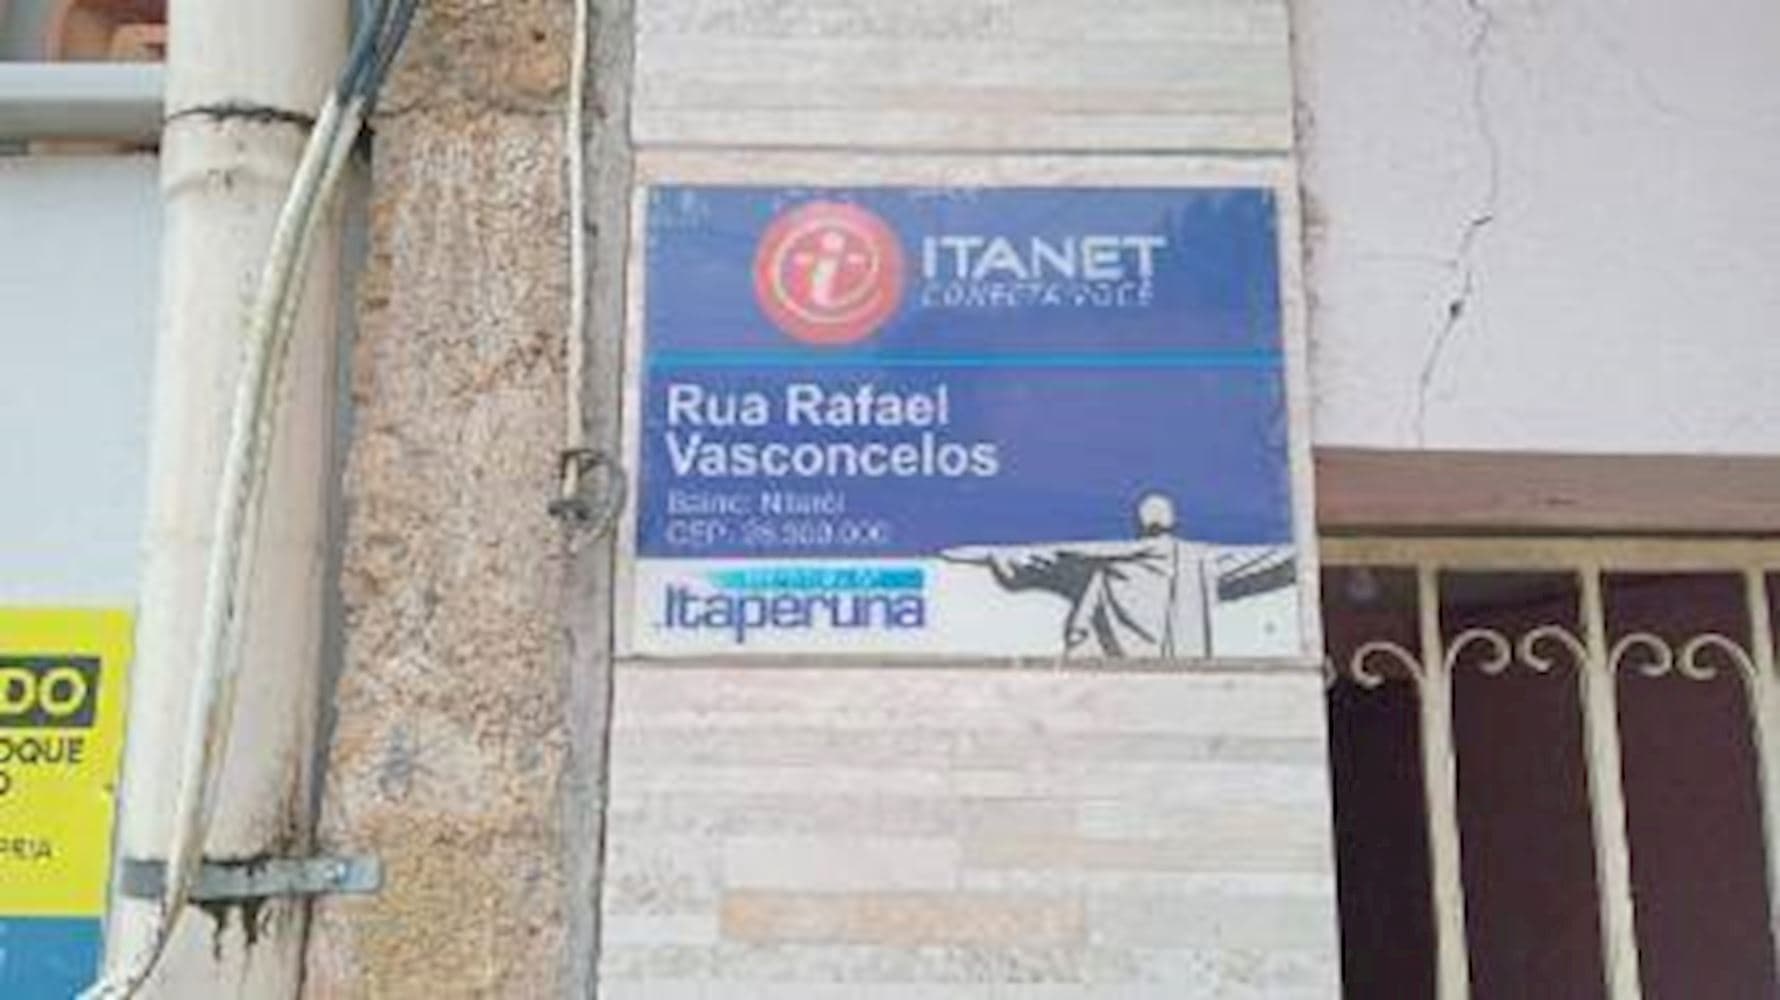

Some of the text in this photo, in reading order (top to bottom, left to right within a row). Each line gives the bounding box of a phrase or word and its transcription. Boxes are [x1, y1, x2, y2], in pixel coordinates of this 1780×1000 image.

[921, 235, 1167, 280] ITANET
[667, 384, 948, 426] Rua Rafael
[666, 434, 999, 478] Vasconcelos
[664, 584, 926, 644] Itaperuna
